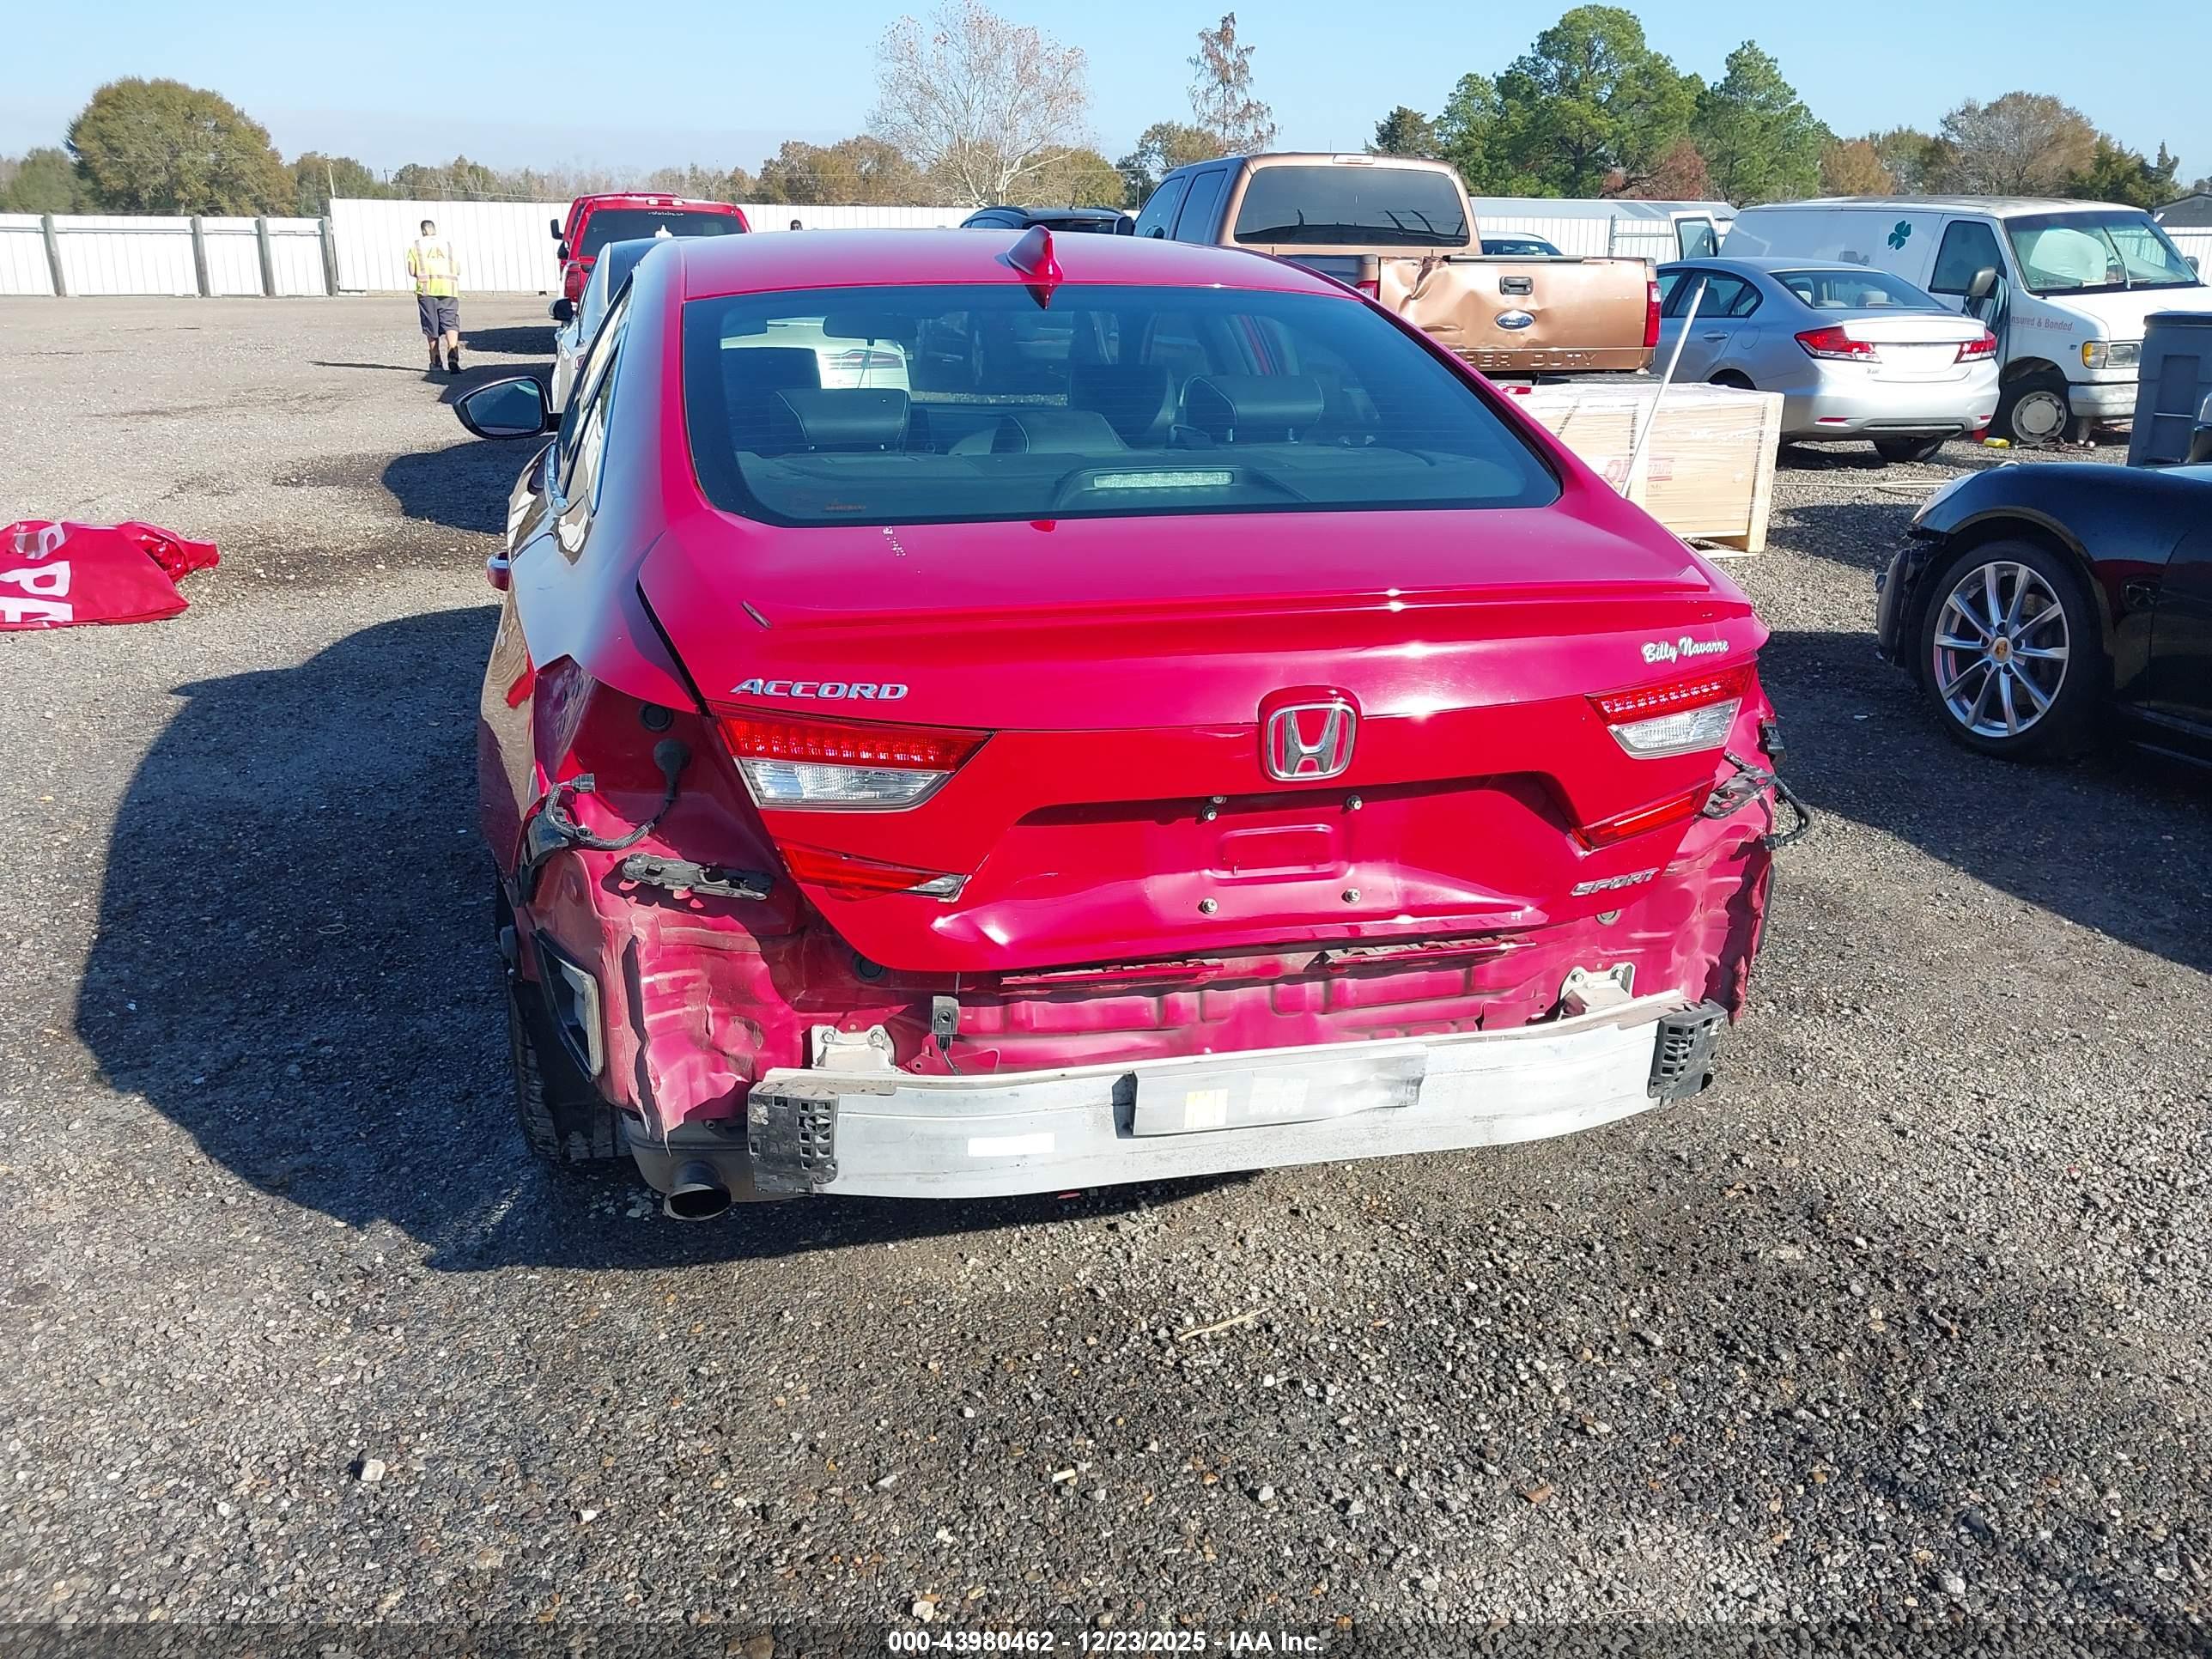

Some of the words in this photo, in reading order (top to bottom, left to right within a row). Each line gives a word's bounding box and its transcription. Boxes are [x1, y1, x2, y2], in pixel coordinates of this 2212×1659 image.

[2010, 315, 2035, 326] nsured
[2045, 318, 2074, 331] Bonded
[1463, 353, 1512, 367] PER
[1529, 353, 1597, 367] DUTY
[1641, 641, 1678, 664] Billy
[1678, 635, 1729, 657] Navarre
[729, 678, 908, 701] ACCORD
[1569, 867, 1661, 896] SPORT
